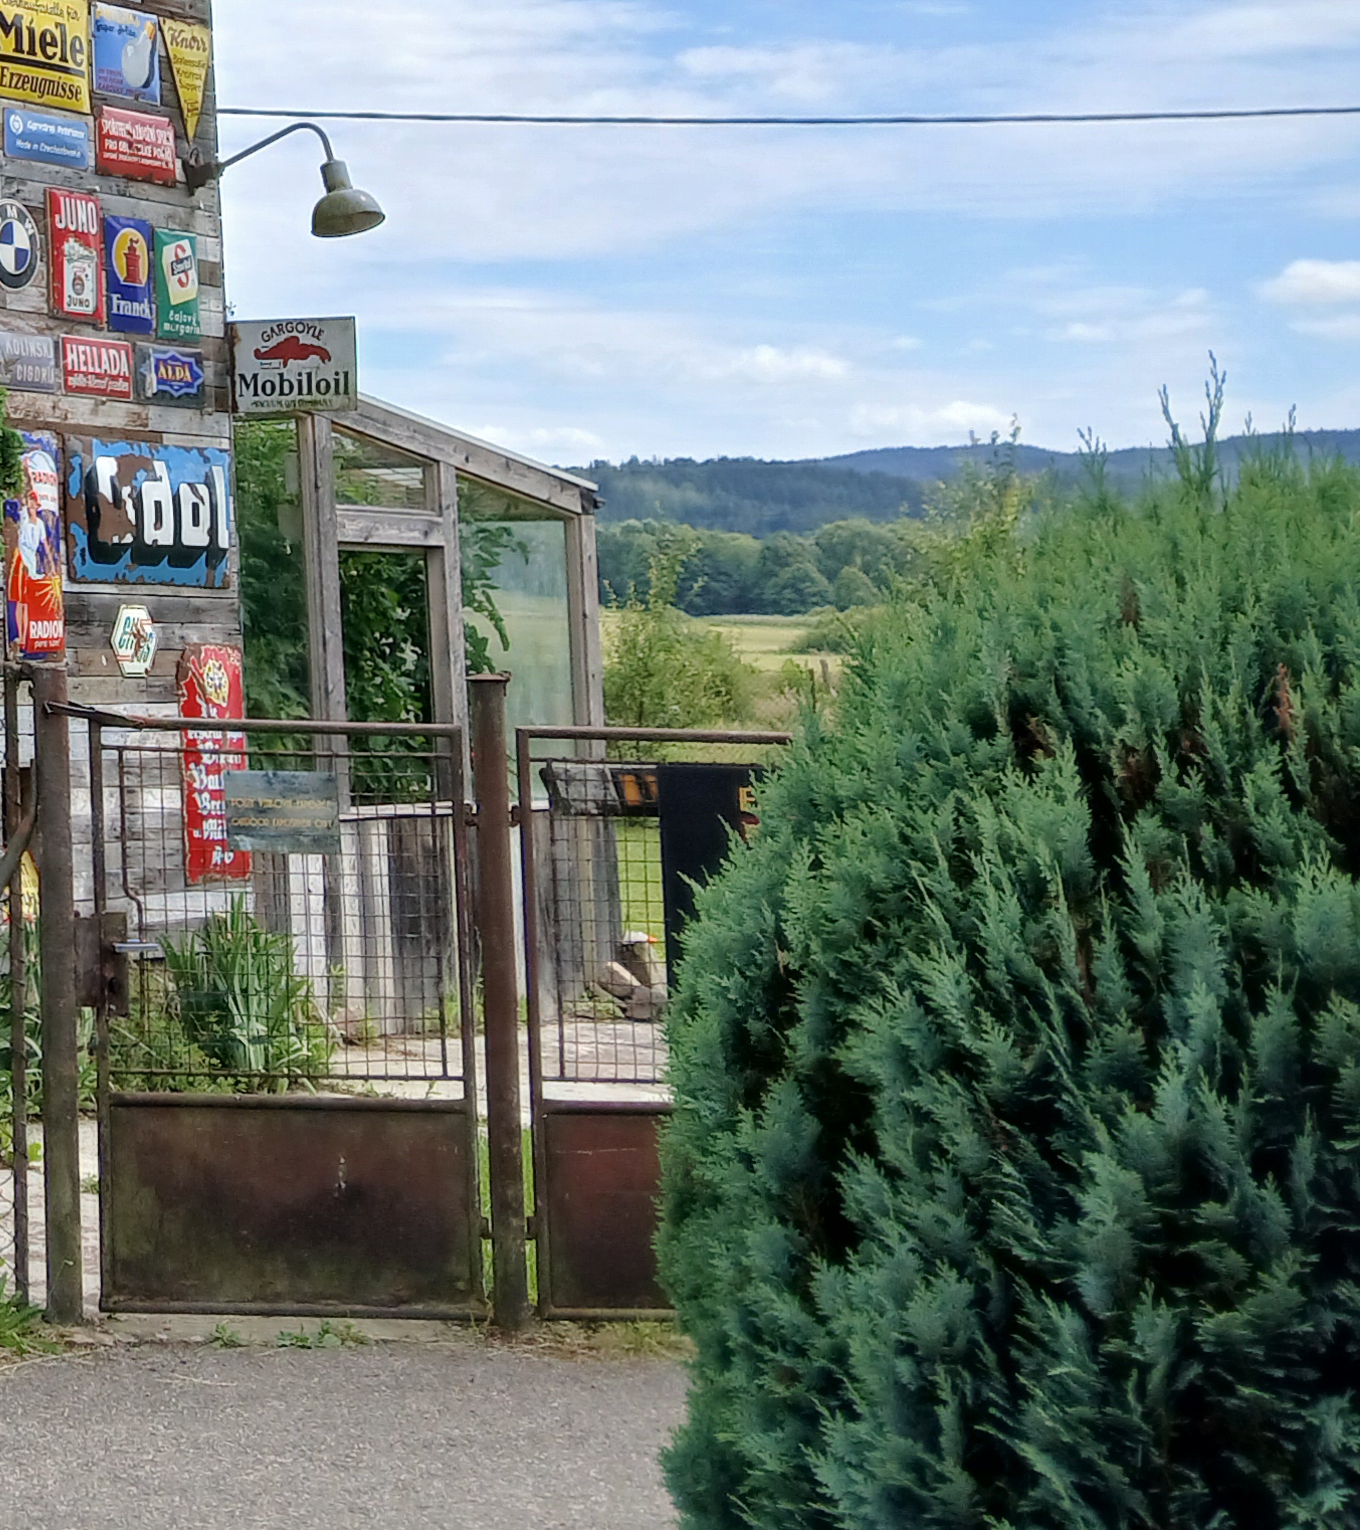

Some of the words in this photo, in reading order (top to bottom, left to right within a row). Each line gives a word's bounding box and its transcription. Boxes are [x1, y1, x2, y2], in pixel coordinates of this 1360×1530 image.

[55, 196, 98, 235] JUNO
[66, 295, 91, 309] JUNO
[111, 293, 152, 320] Franck
[261, 321, 325, 343] GARGOYLE
[66, 343, 130, 377] HELLADA
[238, 370, 350, 398] Mobiloil
[30, 620, 64, 639] RADION
